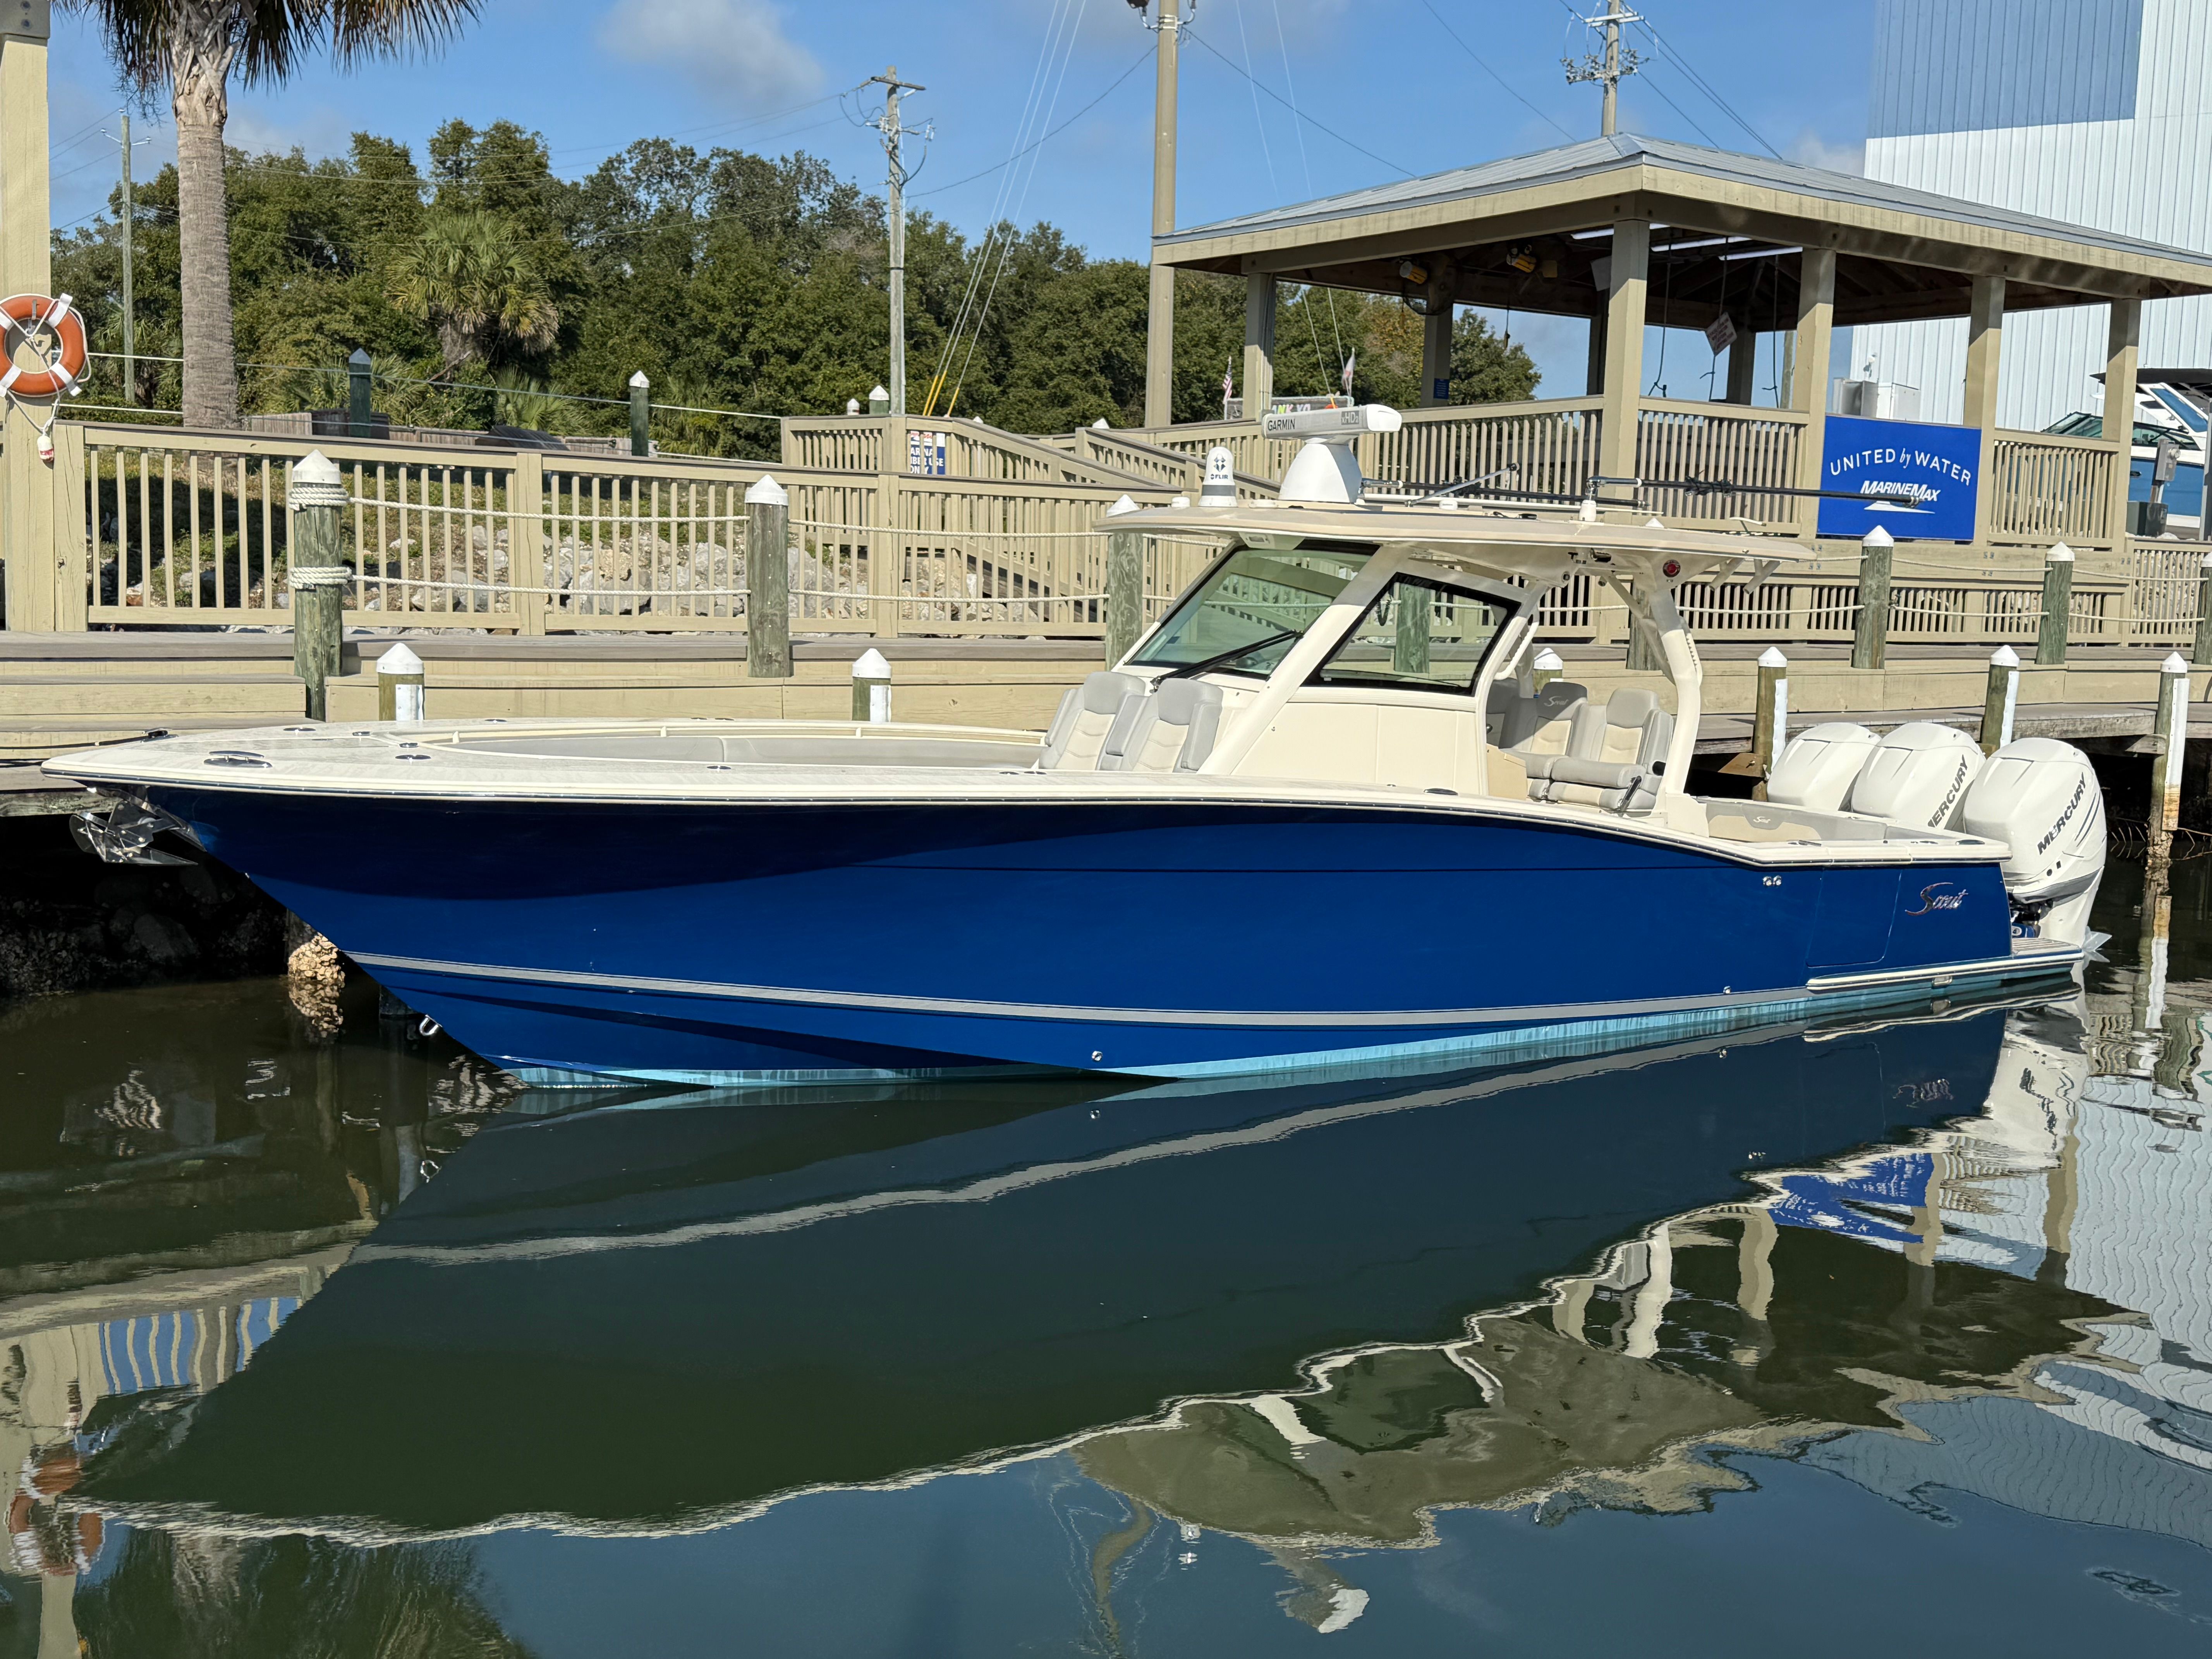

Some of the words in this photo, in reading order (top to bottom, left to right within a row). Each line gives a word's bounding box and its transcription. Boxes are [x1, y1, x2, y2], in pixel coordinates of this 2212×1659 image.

[1267, 419, 1295, 431] GARMIN
[910, 447, 933, 456] ARNA
[910, 465, 929, 474] ONY
[1830, 448, 1896, 476] UNITED
[1899, 448, 1911, 469] by
[1915, 450, 1971, 486] WATER
[2037, 772, 2085, 855] MERCURY
[1905, 882, 1968, 916] Scout
